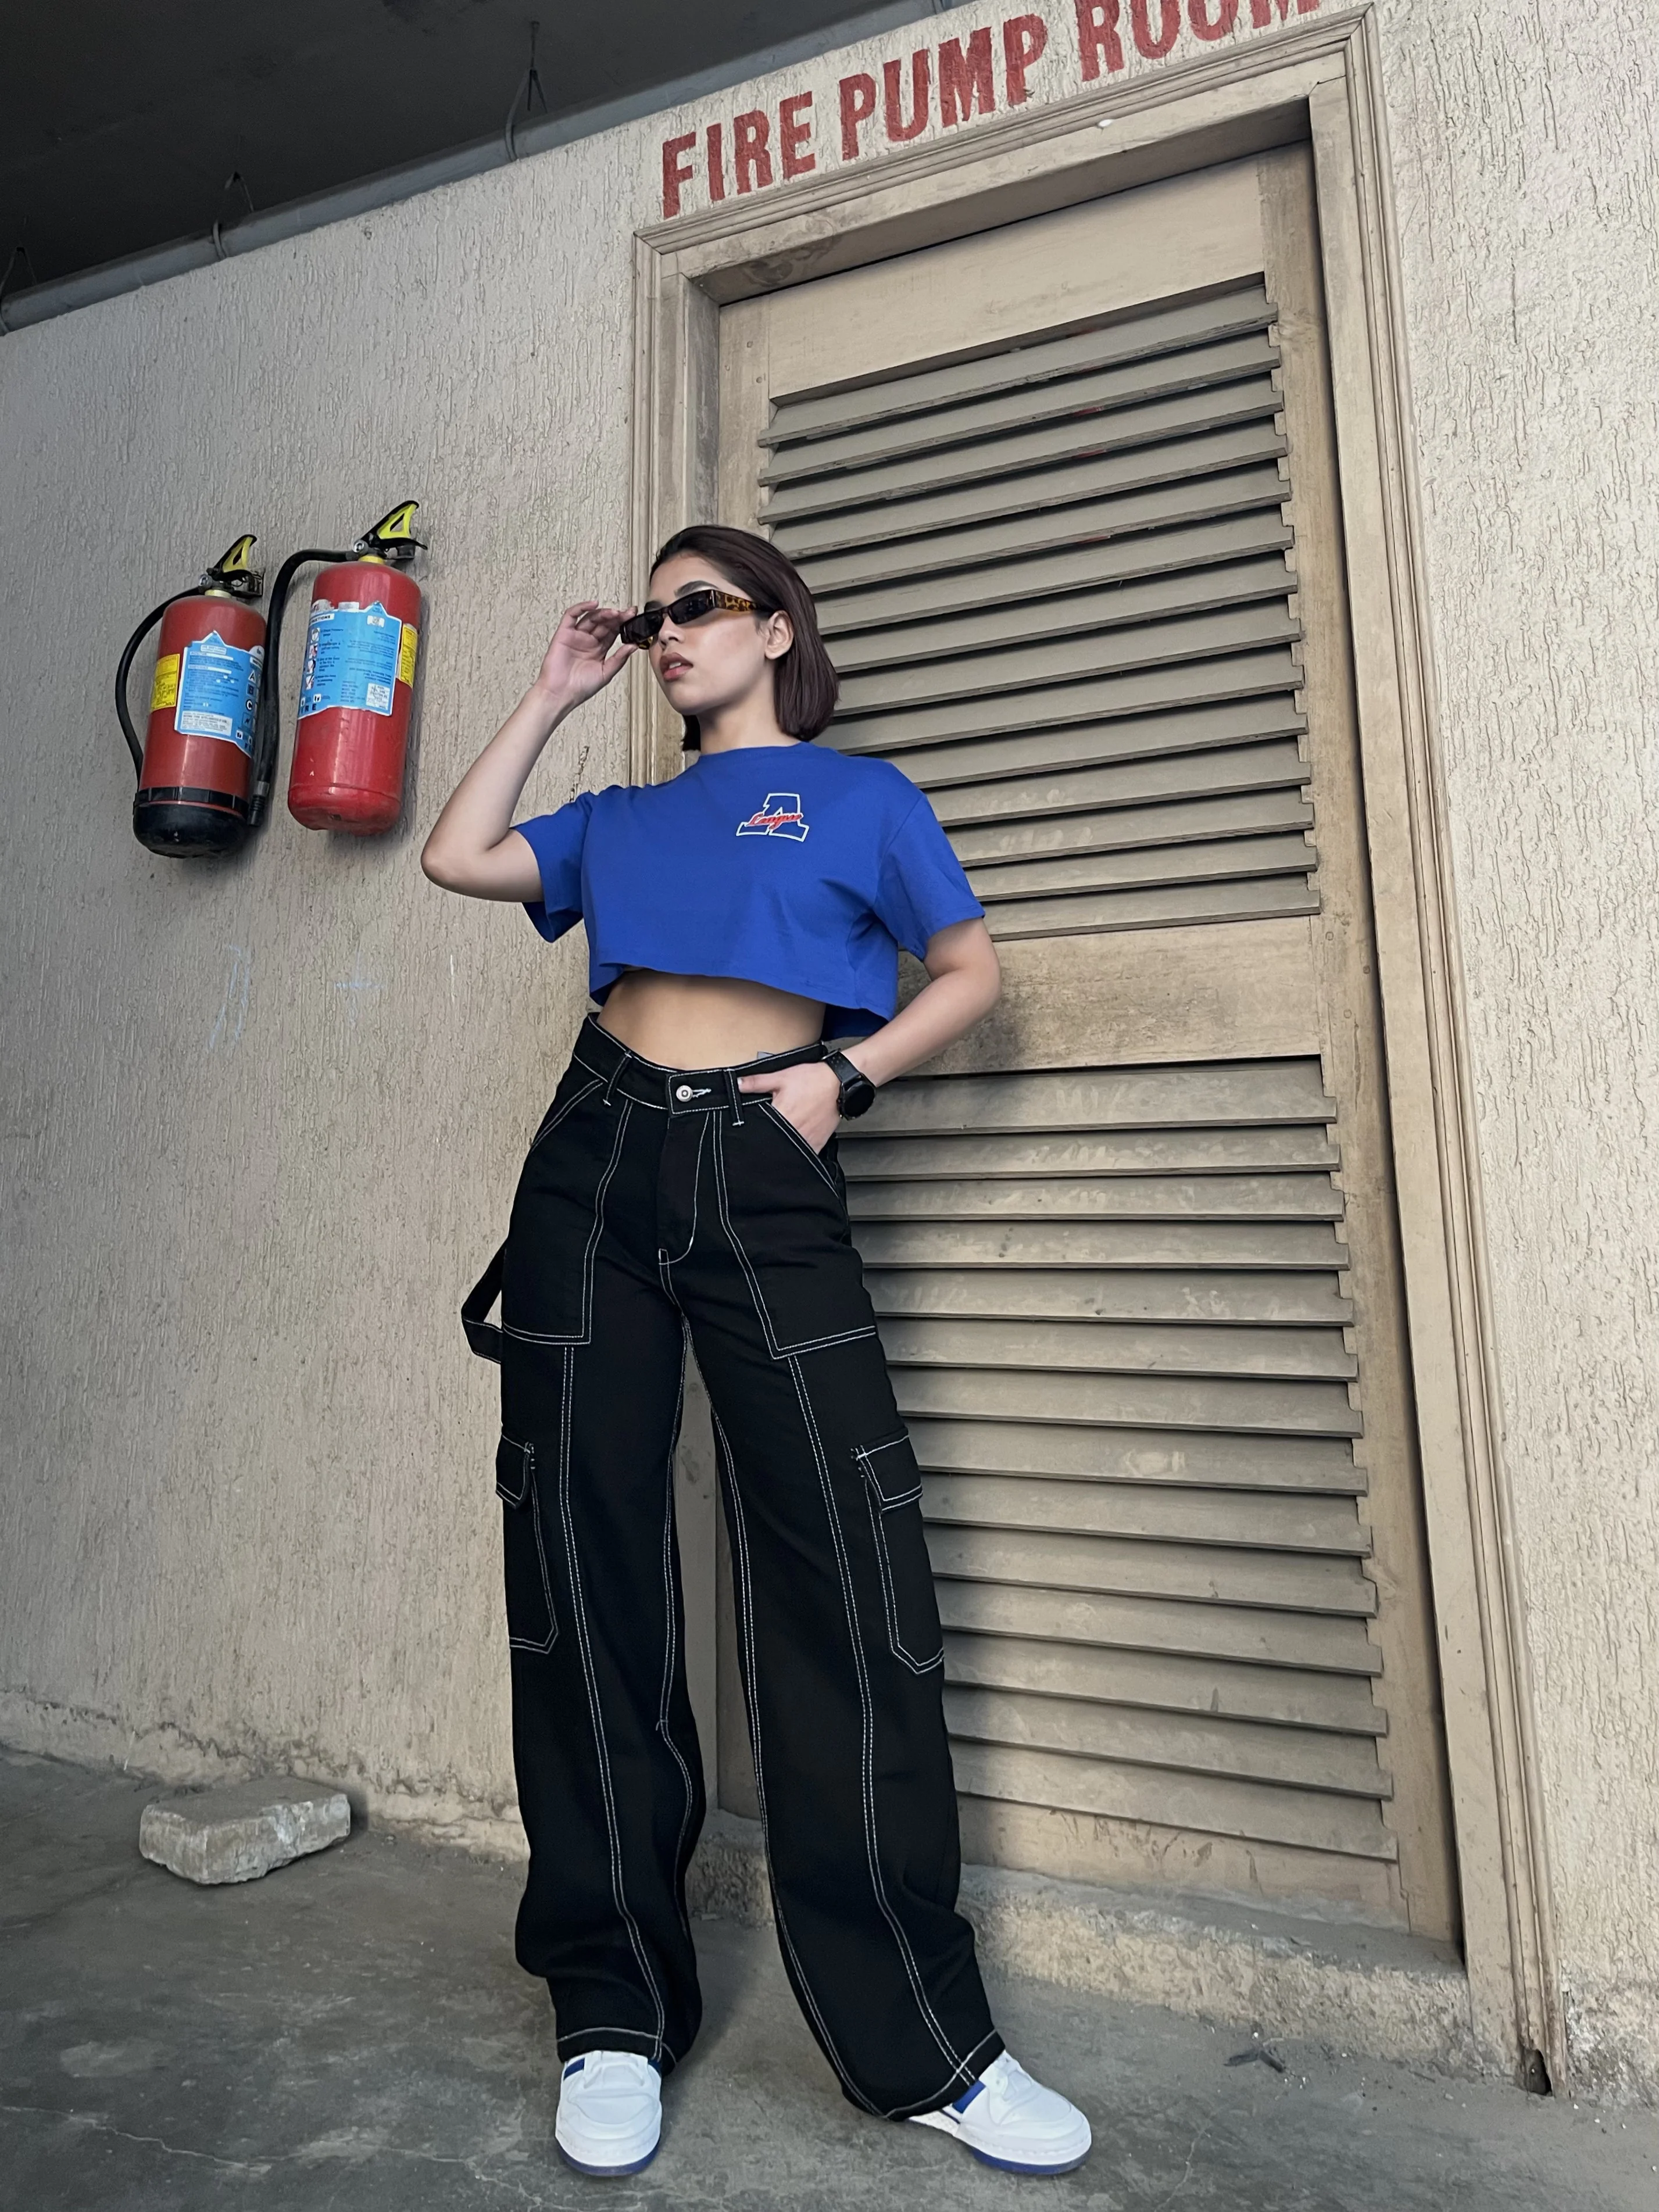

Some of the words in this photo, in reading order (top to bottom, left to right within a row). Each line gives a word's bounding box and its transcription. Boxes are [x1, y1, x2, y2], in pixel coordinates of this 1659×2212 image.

[662, 91, 817, 218] FIRE
[839, 13, 1047, 160] PUMP
[1074, 0, 1320, 81] RO
[246, 700, 253, 710] C
